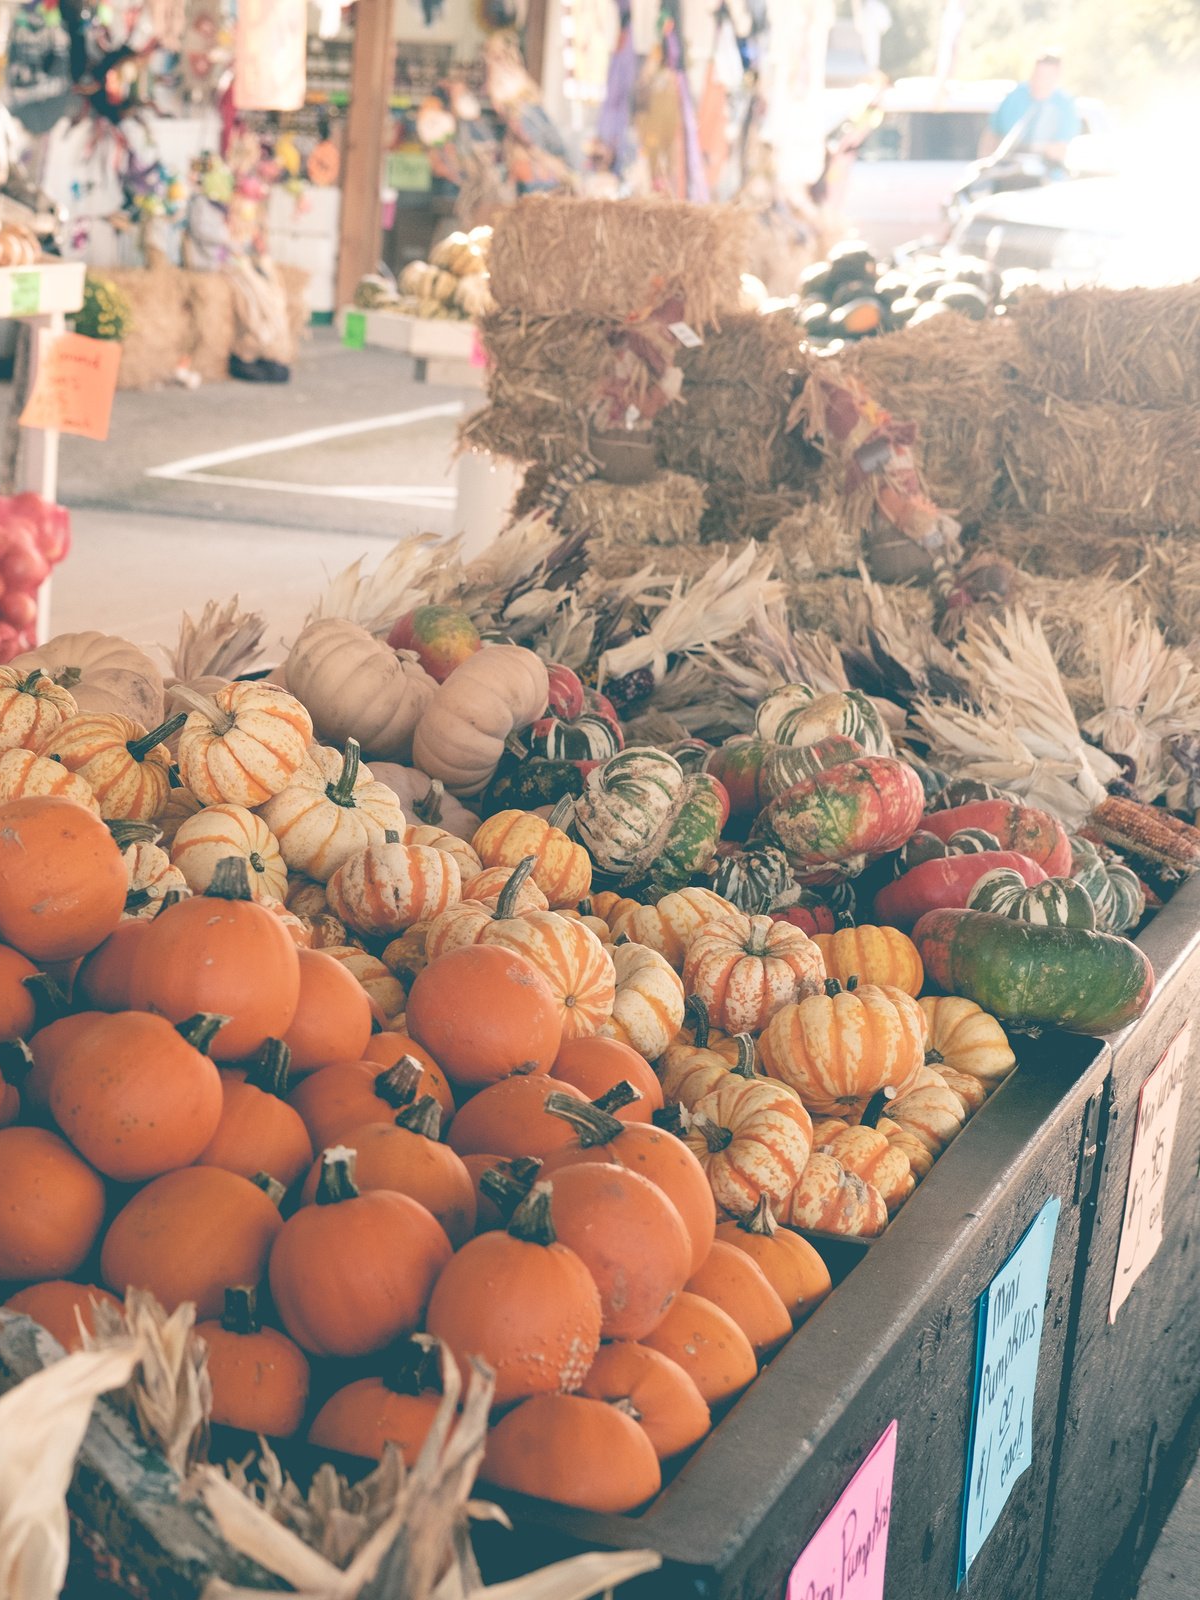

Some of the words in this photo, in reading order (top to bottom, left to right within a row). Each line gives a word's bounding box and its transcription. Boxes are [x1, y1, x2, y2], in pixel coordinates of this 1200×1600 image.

[992, 1260, 1023, 1341] Mini
[982, 1303, 1039, 1418] Pumpkins
[1001, 1396, 1026, 1488] each
